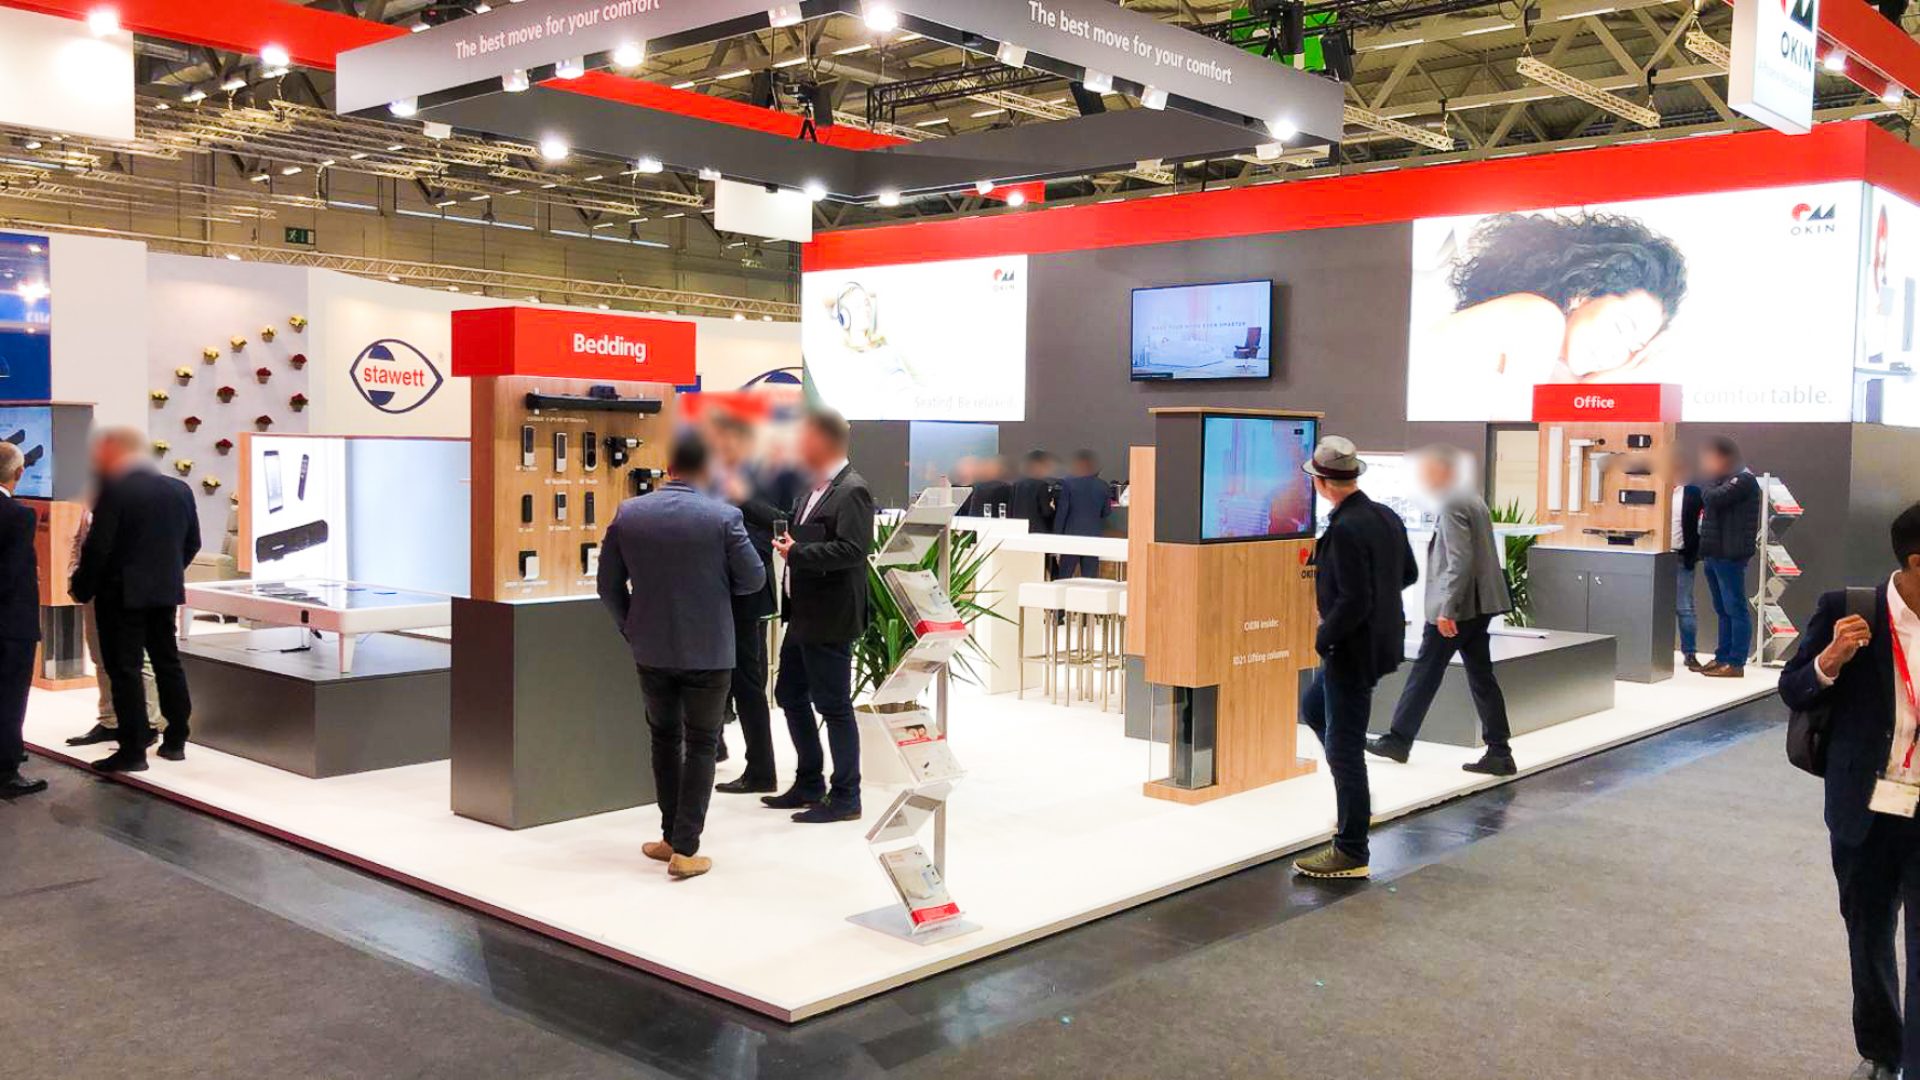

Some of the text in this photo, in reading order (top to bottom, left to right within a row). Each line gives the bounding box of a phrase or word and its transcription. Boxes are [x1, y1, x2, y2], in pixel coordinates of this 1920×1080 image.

[455, 0, 660, 59] The best move for your comfort
[1028, 1, 1232, 85] The best move for your comfort
[1781, 31, 1813, 73] OKIN
[1790, 224, 1836, 236] OKIN
[573, 333, 647, 363] Bedding
[363, 365, 425, 387] stawett
[1573, 395, 1616, 409] Office
[1693, 384, 1833, 405] comfortable.
